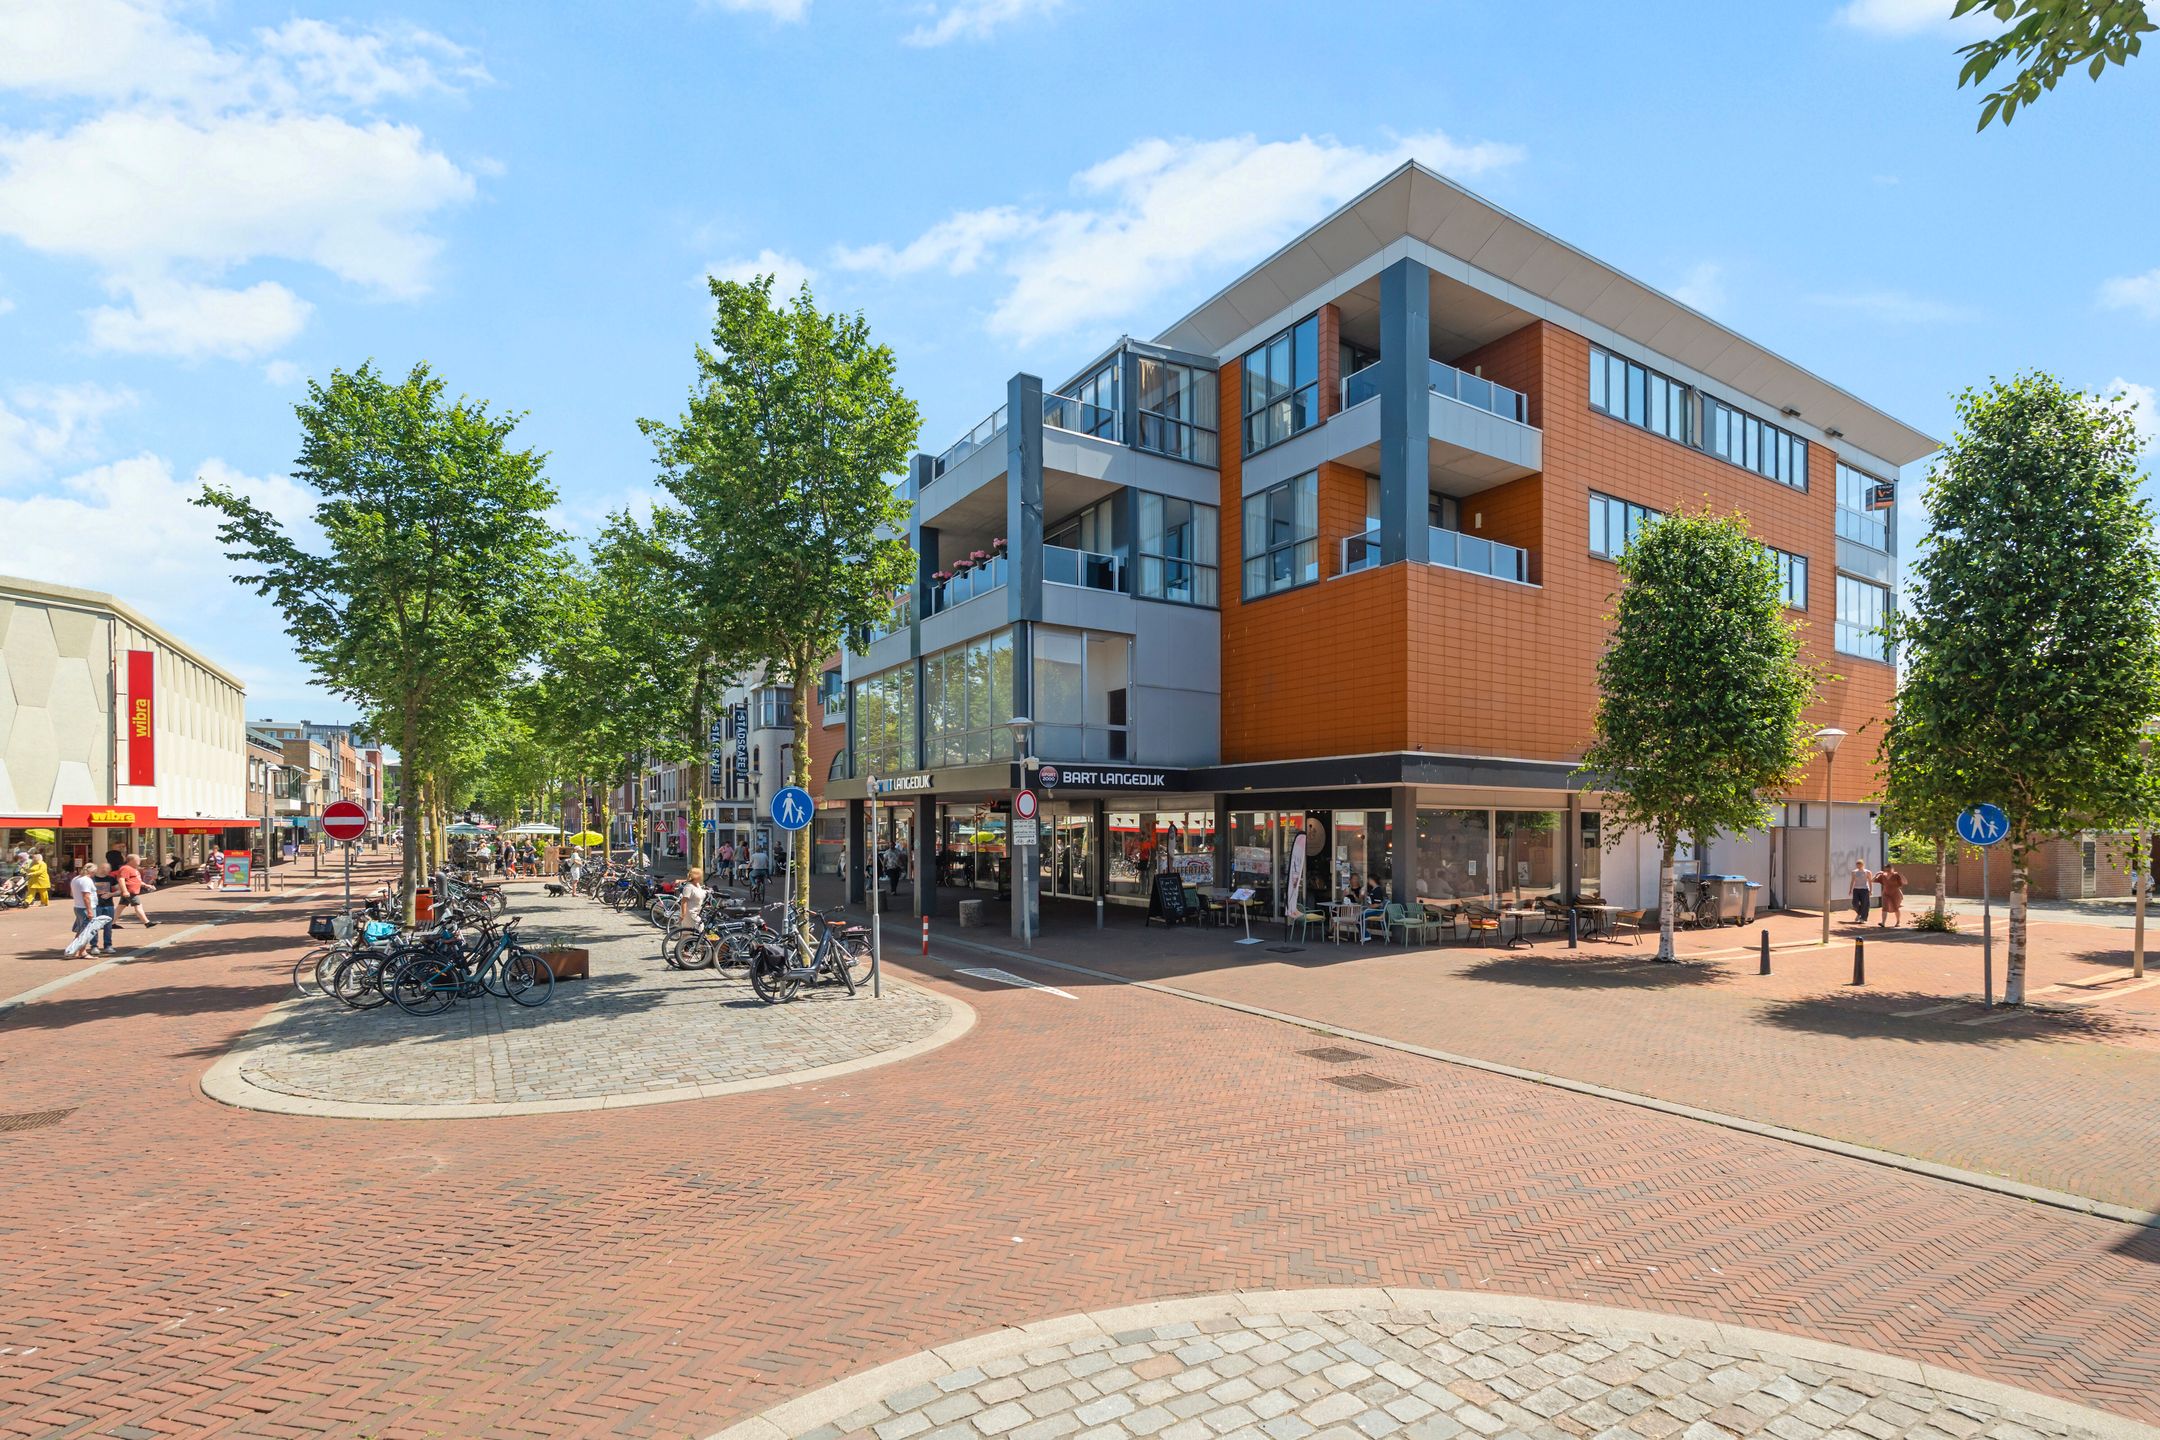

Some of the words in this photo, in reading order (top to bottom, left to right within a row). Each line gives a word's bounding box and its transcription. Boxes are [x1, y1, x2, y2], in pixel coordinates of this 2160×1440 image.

[132, 699, 149, 737] wibra
[712, 726, 720, 774] STASCAFE
[894, 774, 930, 791] LANGEDIJK
[1063, 771, 1097, 784] BART
[1100, 773, 1164, 786] LANGEDIJK
[91, 810, 135, 822] wibra
